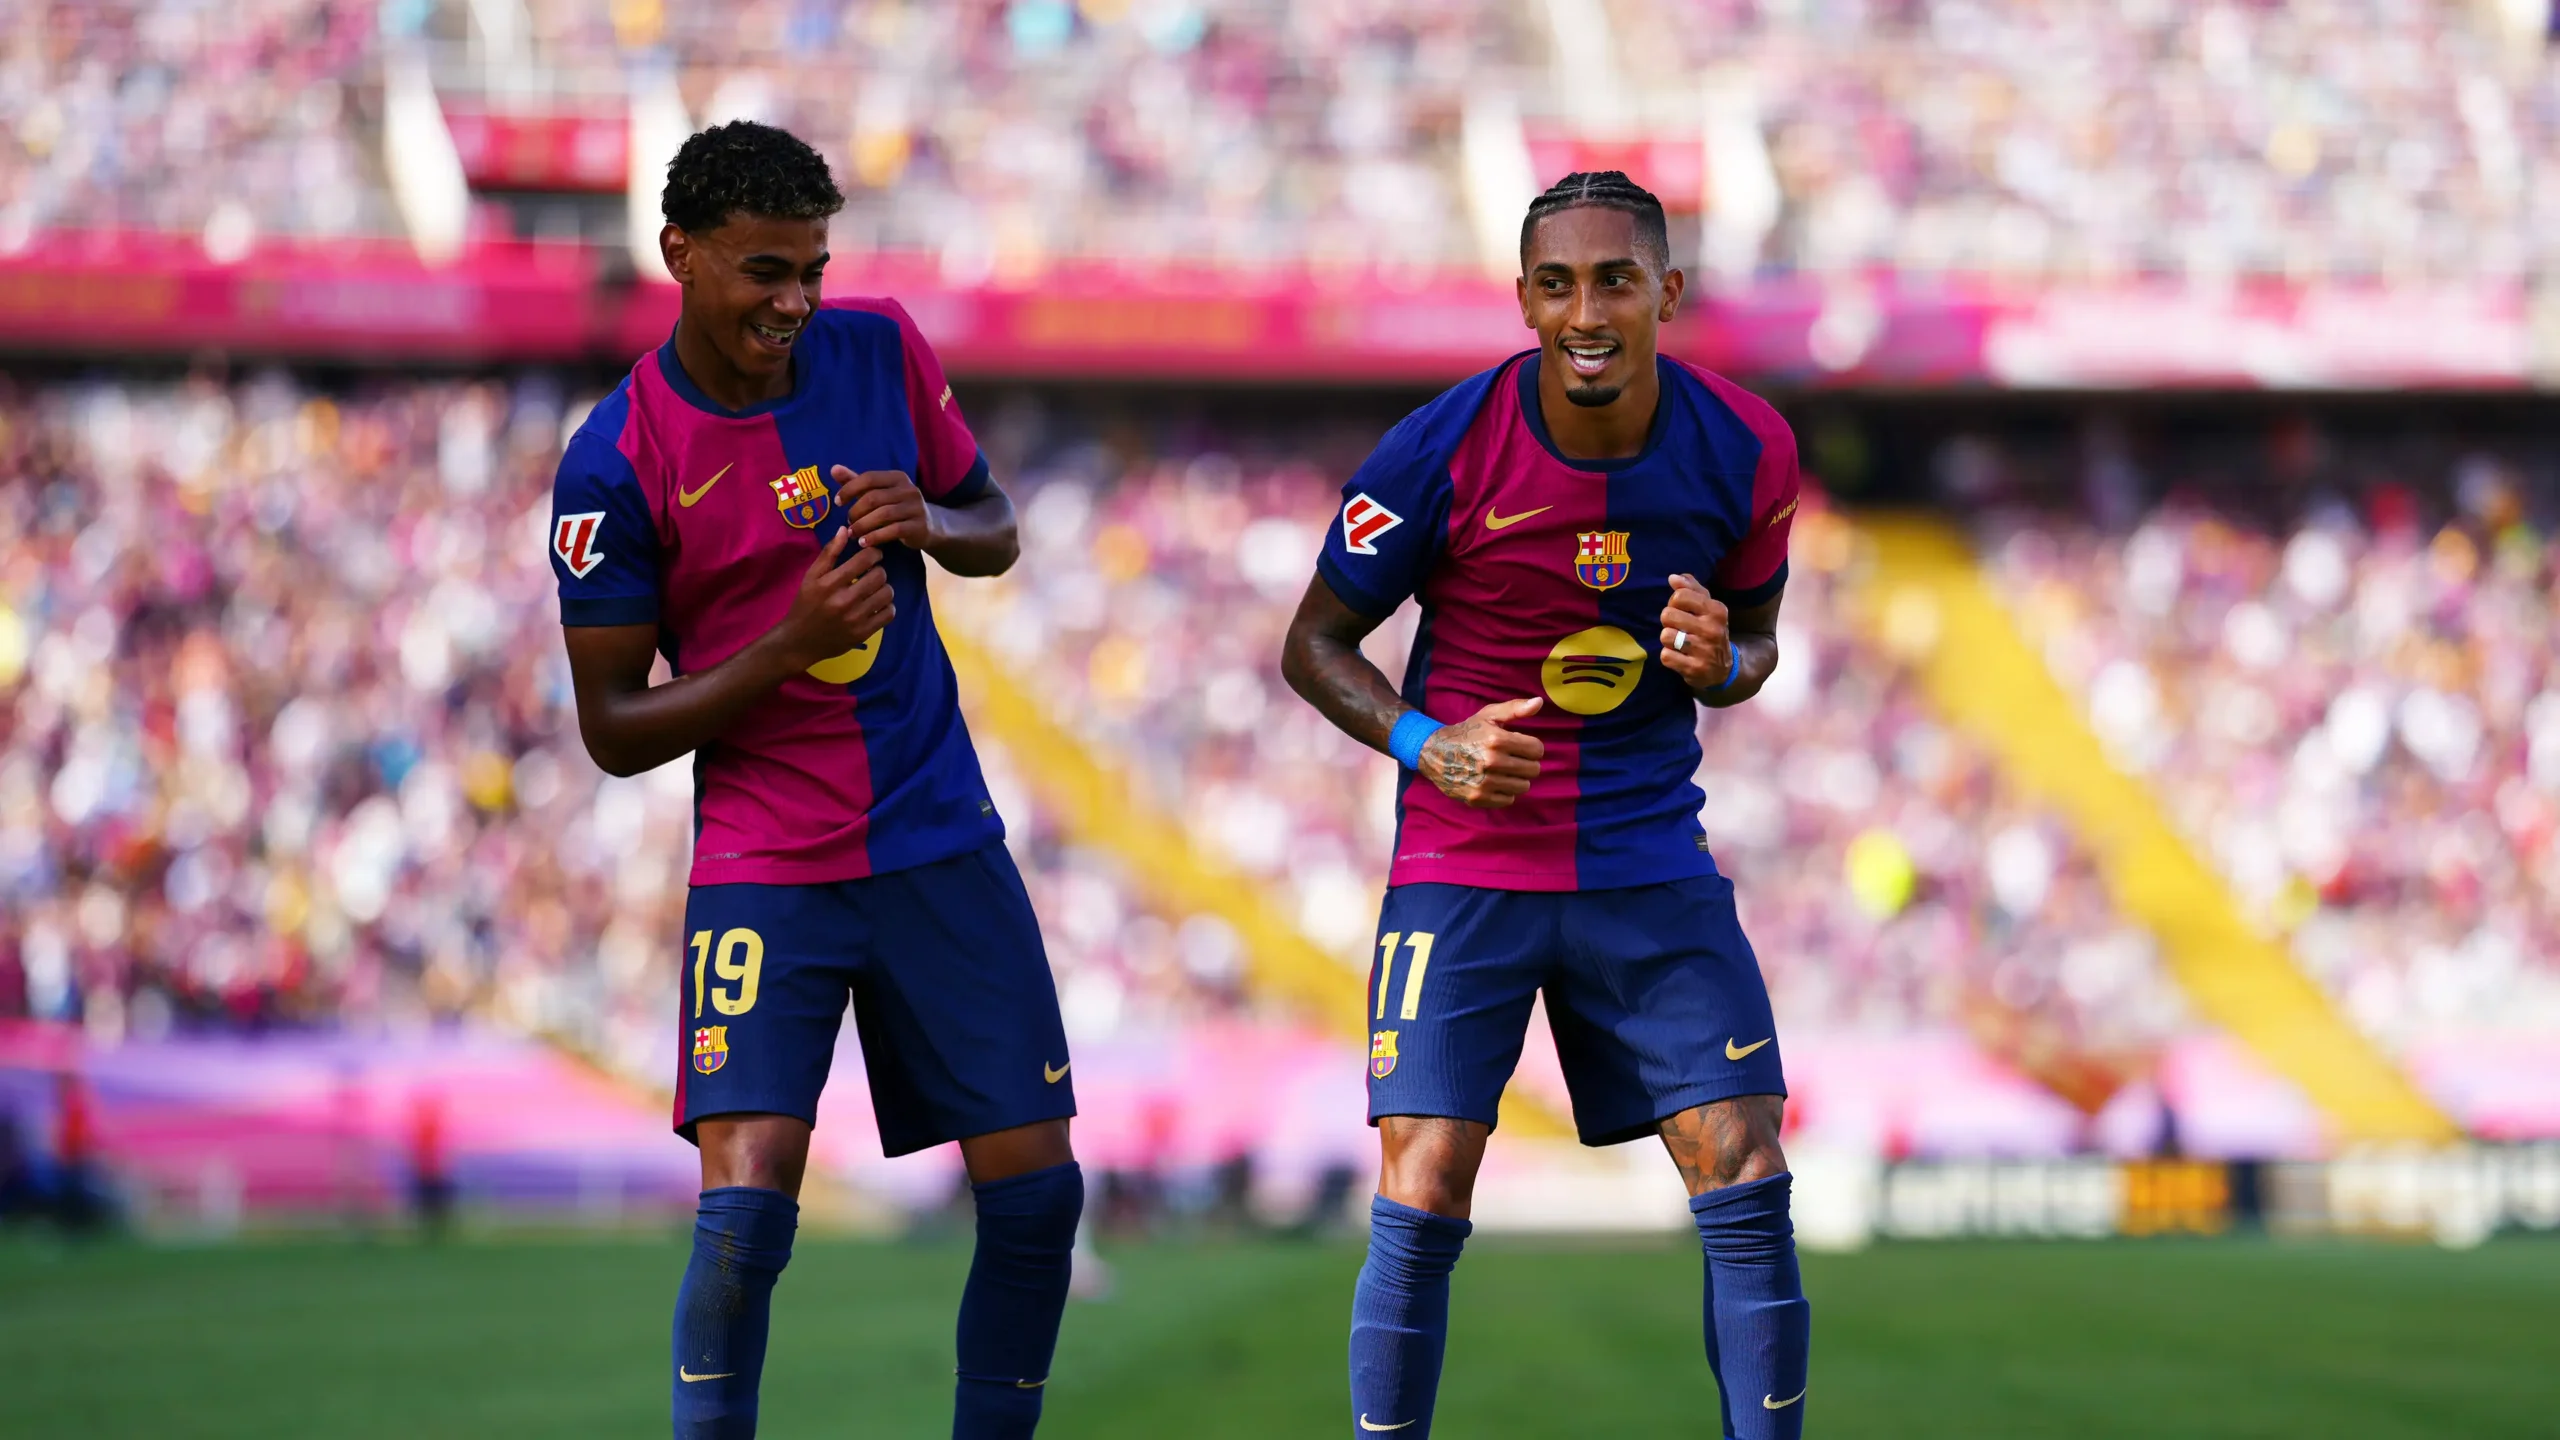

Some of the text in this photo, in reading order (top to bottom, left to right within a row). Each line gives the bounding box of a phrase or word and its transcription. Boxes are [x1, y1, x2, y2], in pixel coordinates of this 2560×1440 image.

[793, 491, 812, 505] FCB
[1592, 555, 1613, 564] FCB
[690, 927, 764, 1019] 19
[1376, 931, 1435, 1020] 11
